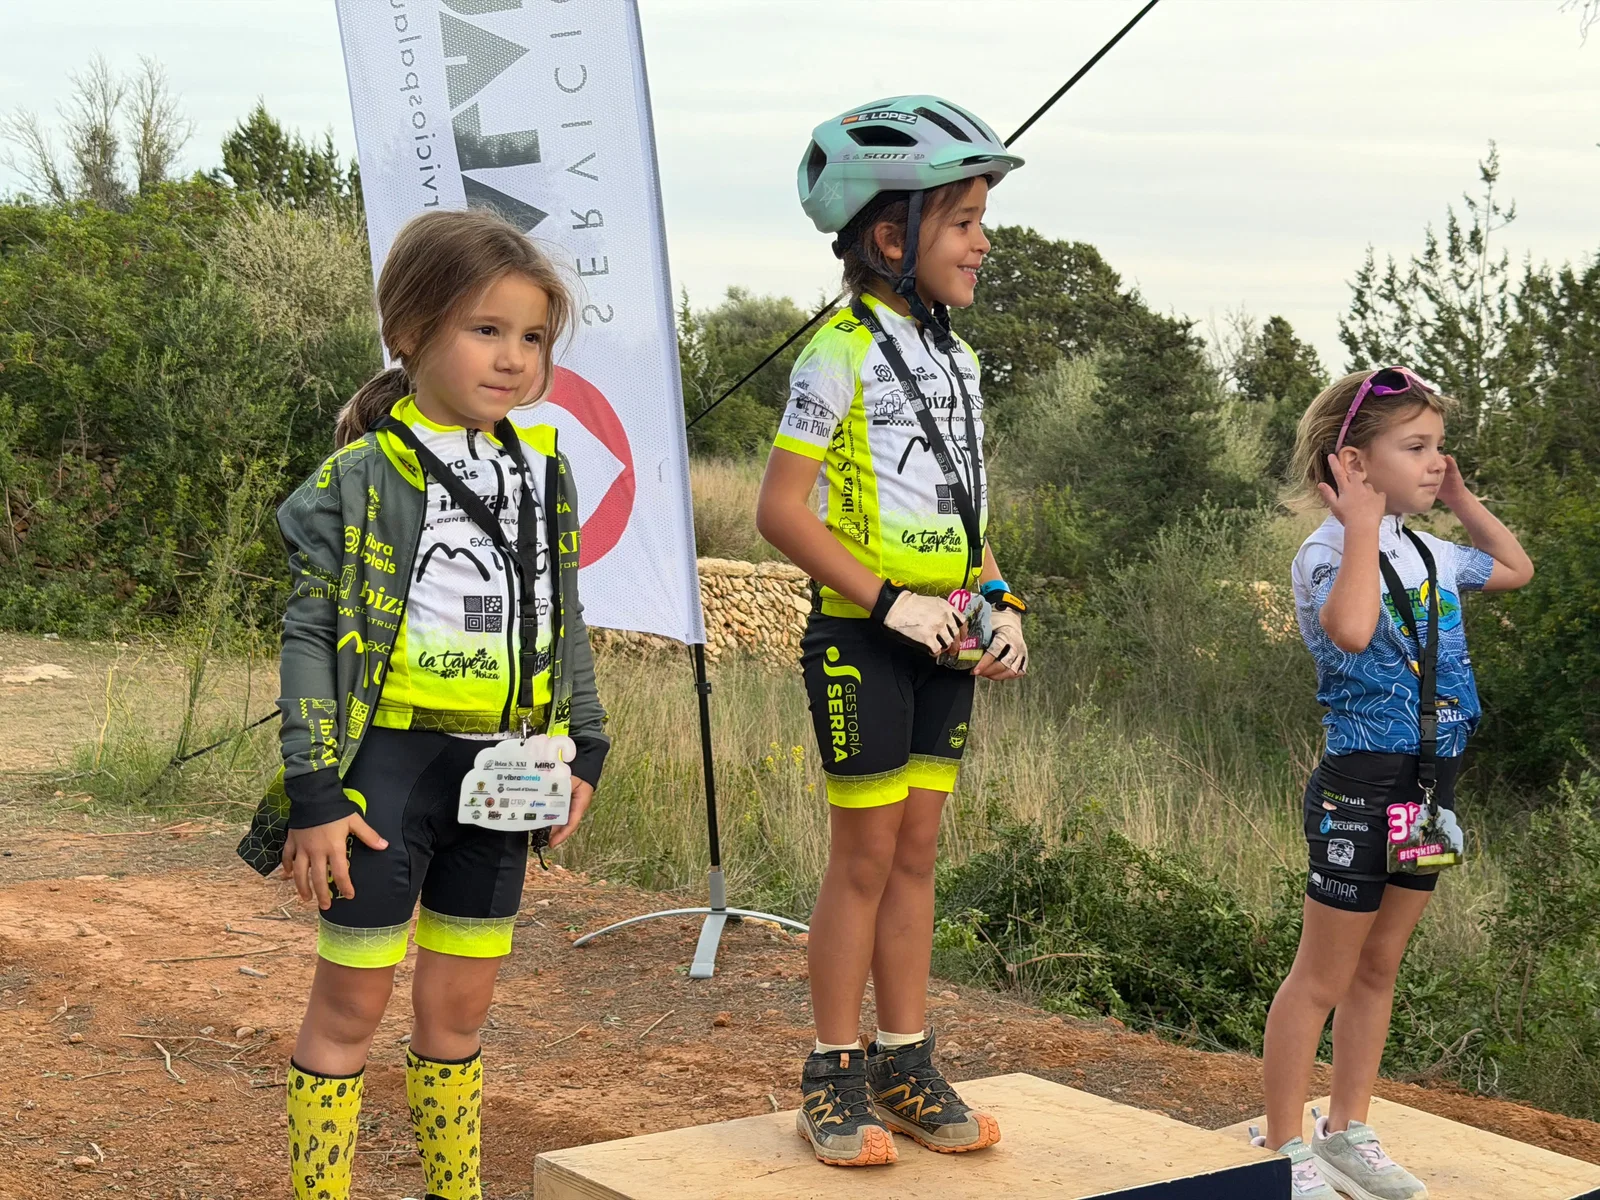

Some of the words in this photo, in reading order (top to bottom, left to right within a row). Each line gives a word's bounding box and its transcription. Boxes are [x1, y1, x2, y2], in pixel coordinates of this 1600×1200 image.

[871, 112, 918, 124] LOPEZ
[810, 419, 831, 439] Pilot
[841, 476, 855, 513] ibiza
[418, 650, 437, 668] la
[826, 683, 849, 763] SERRA
